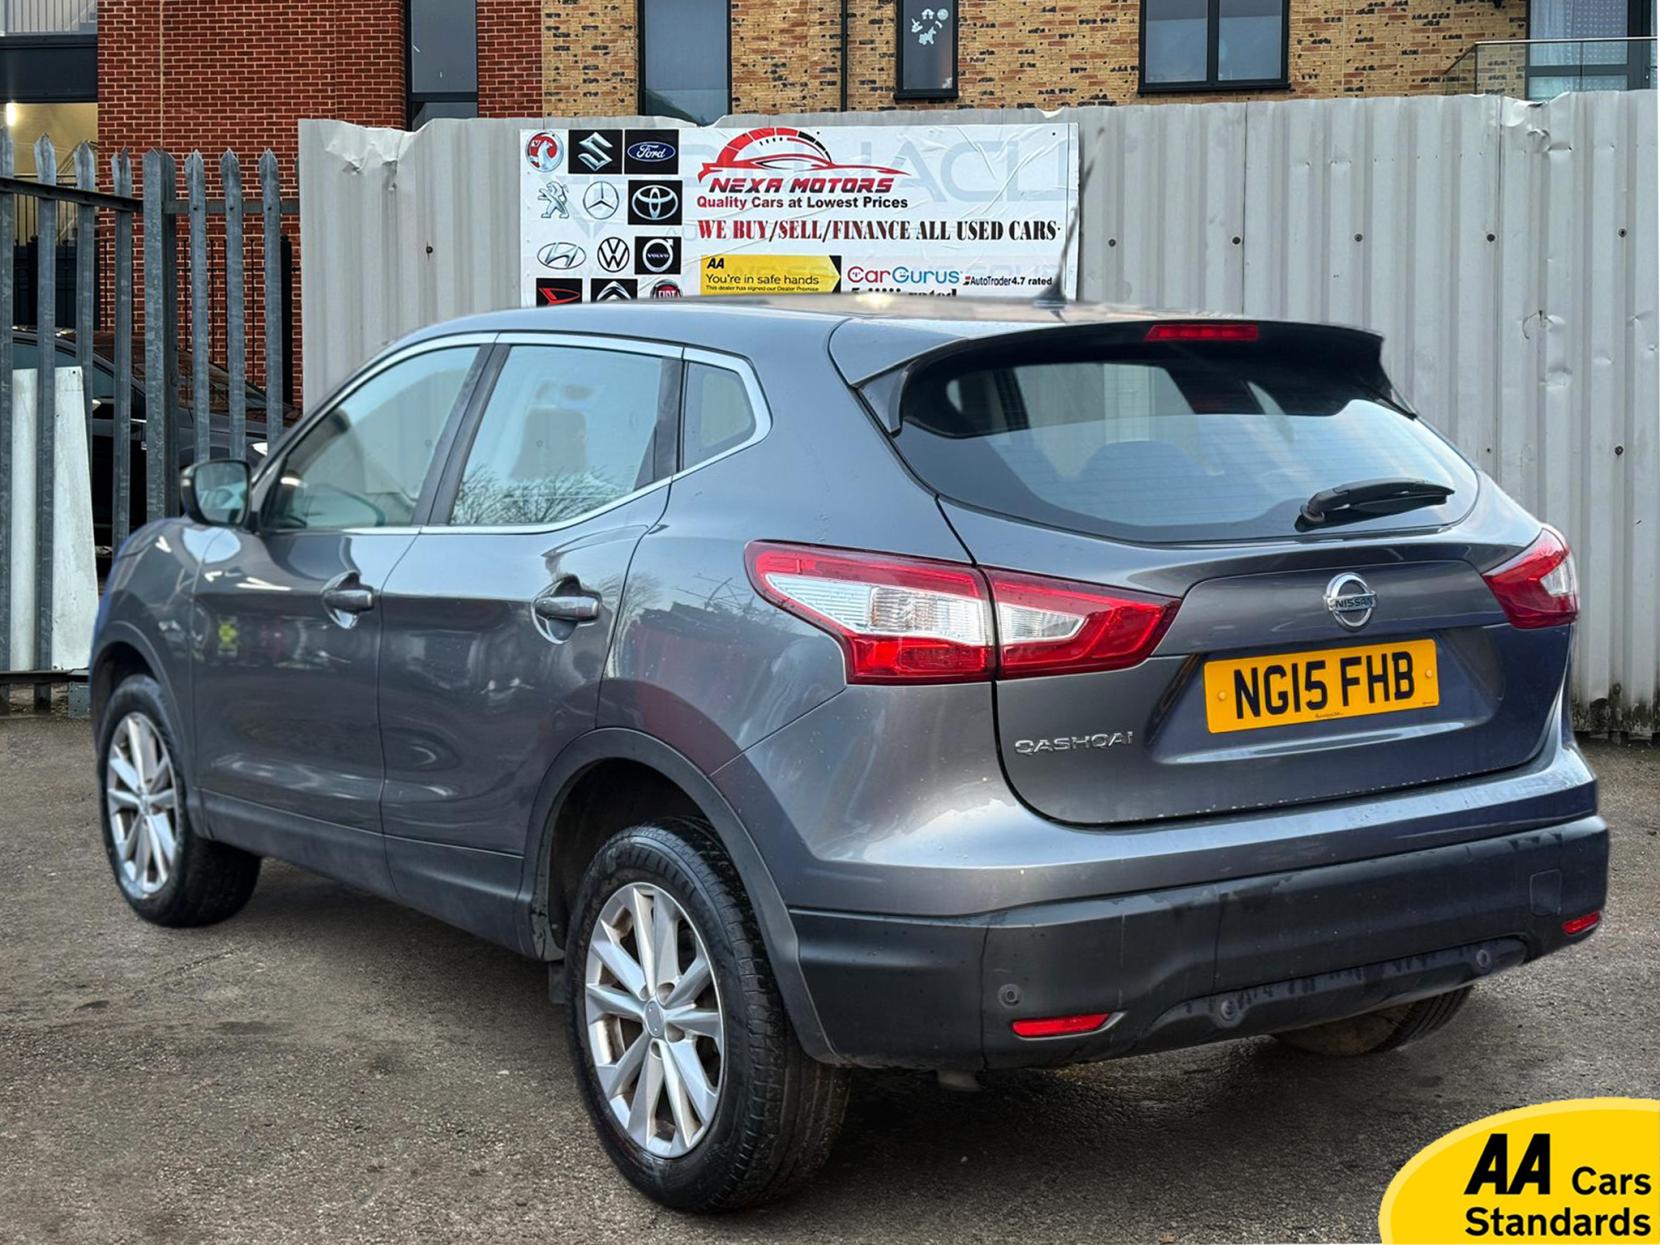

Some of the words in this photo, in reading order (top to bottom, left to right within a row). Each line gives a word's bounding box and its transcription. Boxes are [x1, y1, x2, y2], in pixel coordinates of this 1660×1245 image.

[636, 144, 666, 158] Ford
[709, 178, 784, 193] NEXA
[789, 178, 894, 193] MOTORS
[697, 196, 747, 211] Quality
[751, 196, 784, 208] Cars
[788, 197, 803, 208] at
[807, 196, 858, 208] Lowest
[863, 196, 908, 208] Prices
[697, 219, 727, 240] WE
[916, 220, 951, 241] ALL
[956, 220, 1004, 241] USED
[1008, 220, 1057, 241] CARS
[706, 257, 725, 269] AA
[706, 273, 741, 284] You're
[744, 274, 754, 284] in
[757, 274, 781, 285] safe
[784, 274, 820, 285] hands
[847, 265, 960, 284] CarGurus
[1028, 276, 1053, 286] rated
[1335, 596, 1372, 608] NISSAN
[1233, 659, 1328, 720] NG15
[1340, 650, 1415, 707] FHB
[1015, 730, 1134, 756] QASHQAI
